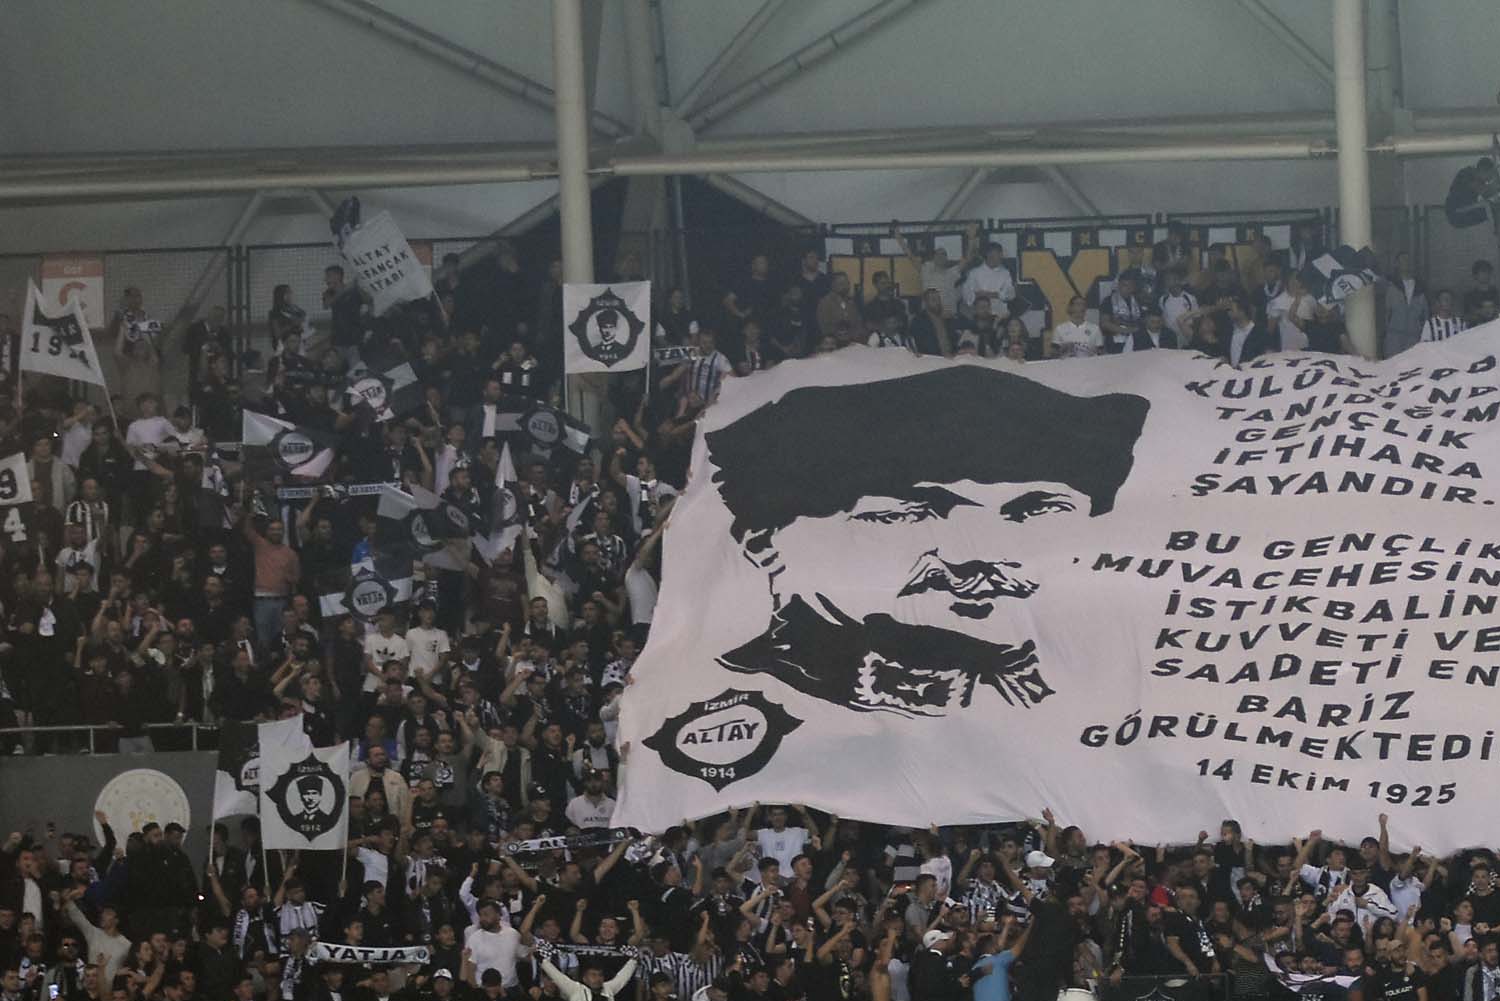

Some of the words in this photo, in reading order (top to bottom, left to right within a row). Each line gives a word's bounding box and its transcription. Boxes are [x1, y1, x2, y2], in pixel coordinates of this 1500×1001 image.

[1235, 409, 1476, 450] GENÇLİK
[1189, 471, 1496, 505] ŞAYANDIR.
[1165, 530, 1241, 555] BU
[1164, 589, 1498, 623] İSTİKBALİN
[1154, 622, 1409, 652] KUVVETİ
[1150, 653, 1403, 687] SAADETİ
[1427, 659, 1500, 687] EN
[704, 693, 750, 712] İZMİR
[1236, 690, 1415, 728] BARİZ
[682, 718, 760, 746] ALTAY
[700, 767, 736, 779] 1914
[1196, 758, 1234, 781] 14
[1250, 764, 1351, 792] EKİM
[1367, 780, 1457, 807] 1925
